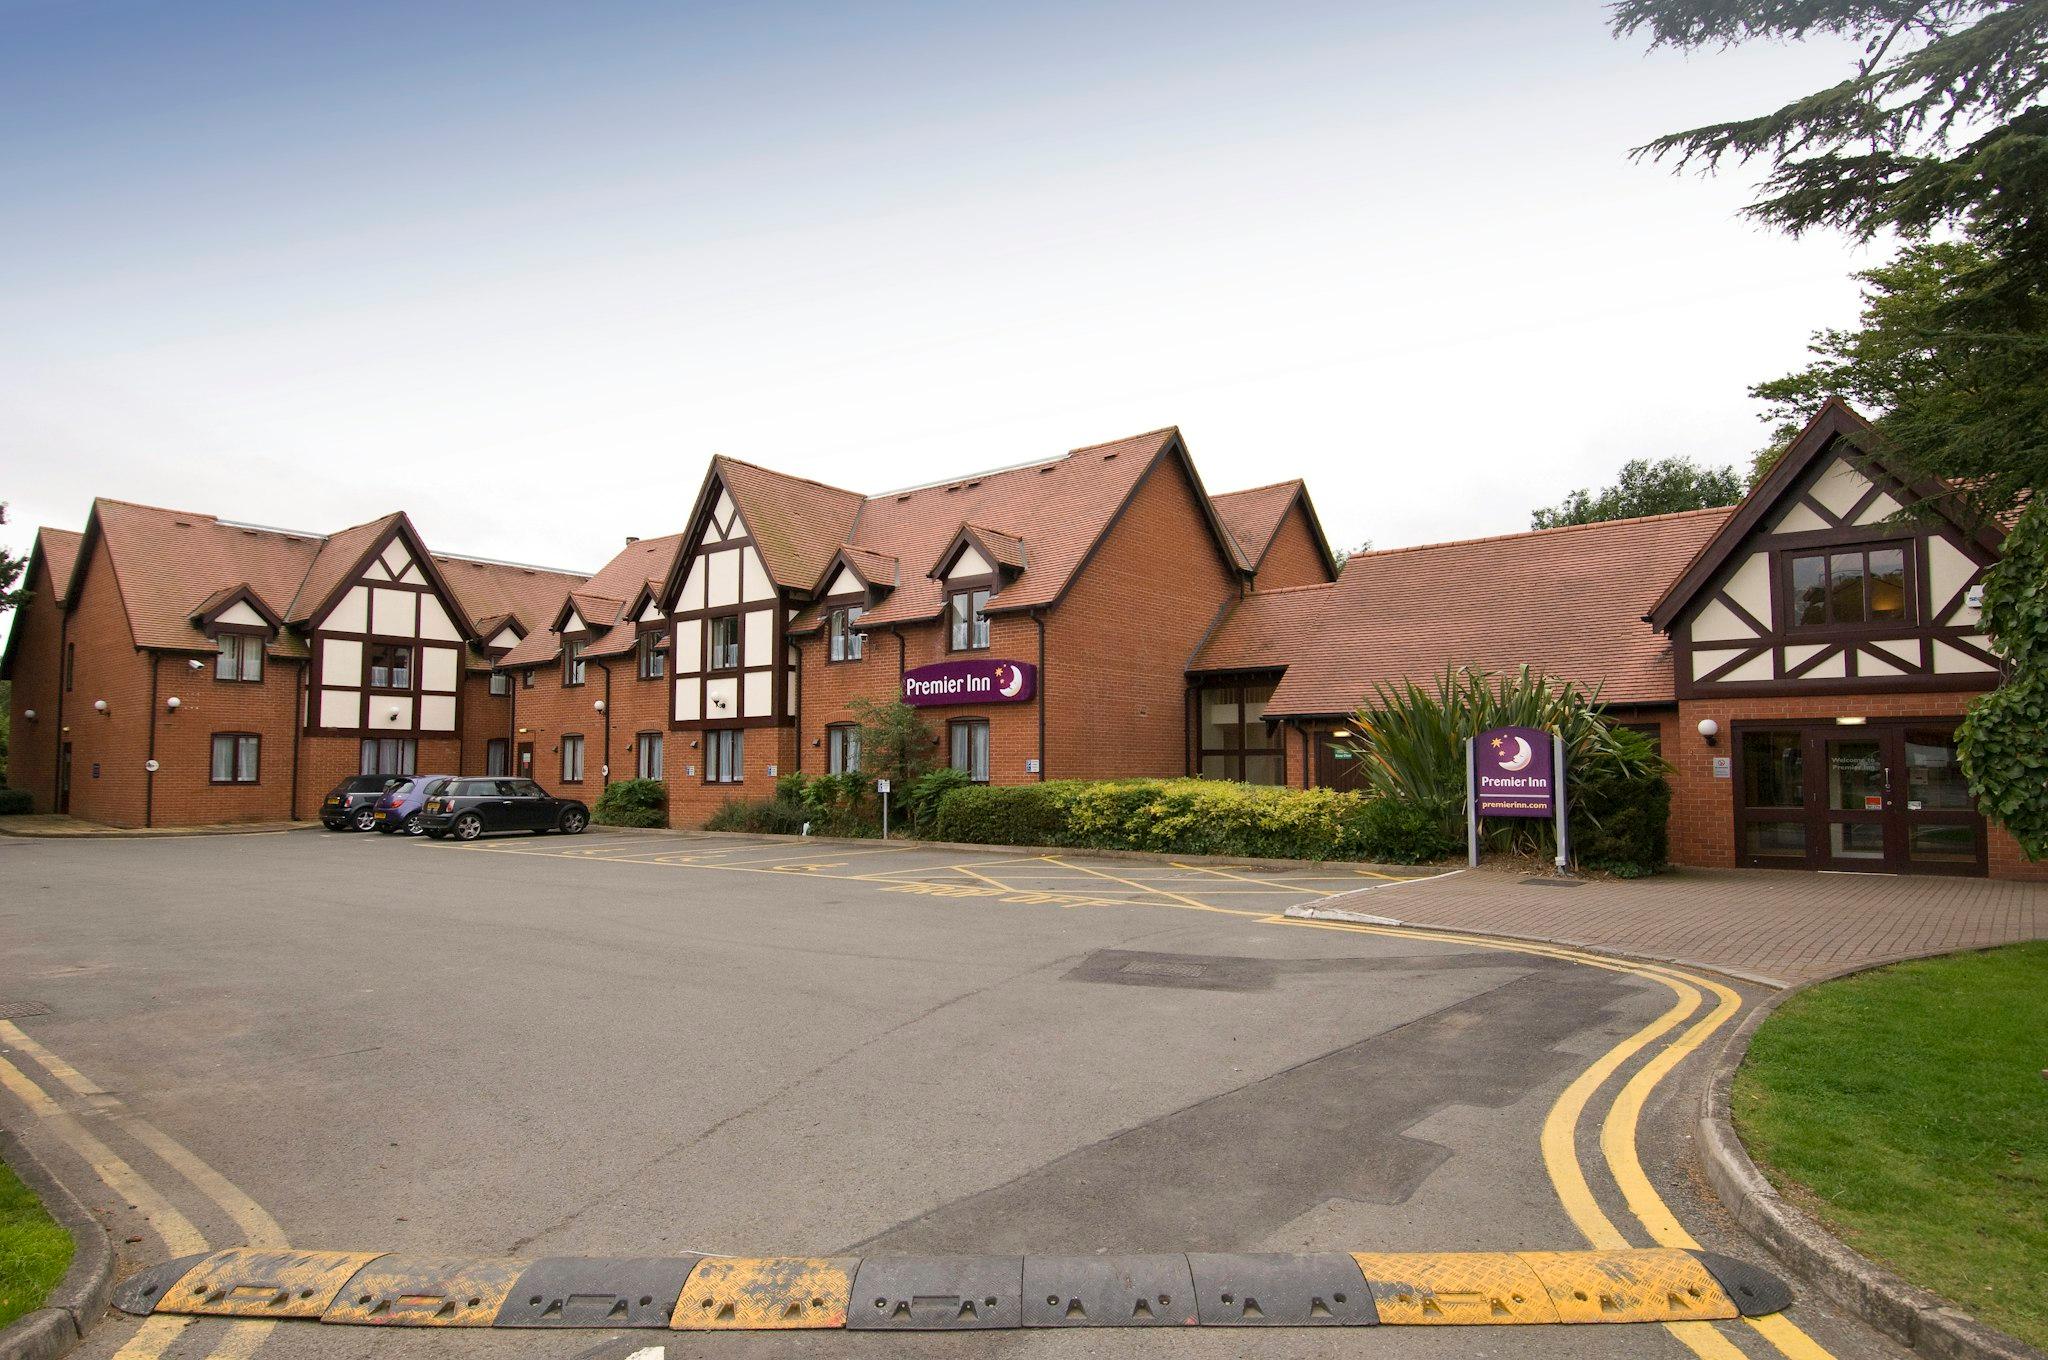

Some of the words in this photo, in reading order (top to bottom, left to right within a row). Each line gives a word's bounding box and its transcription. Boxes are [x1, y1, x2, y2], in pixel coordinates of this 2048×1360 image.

[907, 676, 964, 696] Premier
[967, 674, 991, 692] Inn
[1482, 777, 1526, 787] Premier
[1529, 776, 1547, 787] Inn
[1482, 801, 1548, 809] premierinn.com
